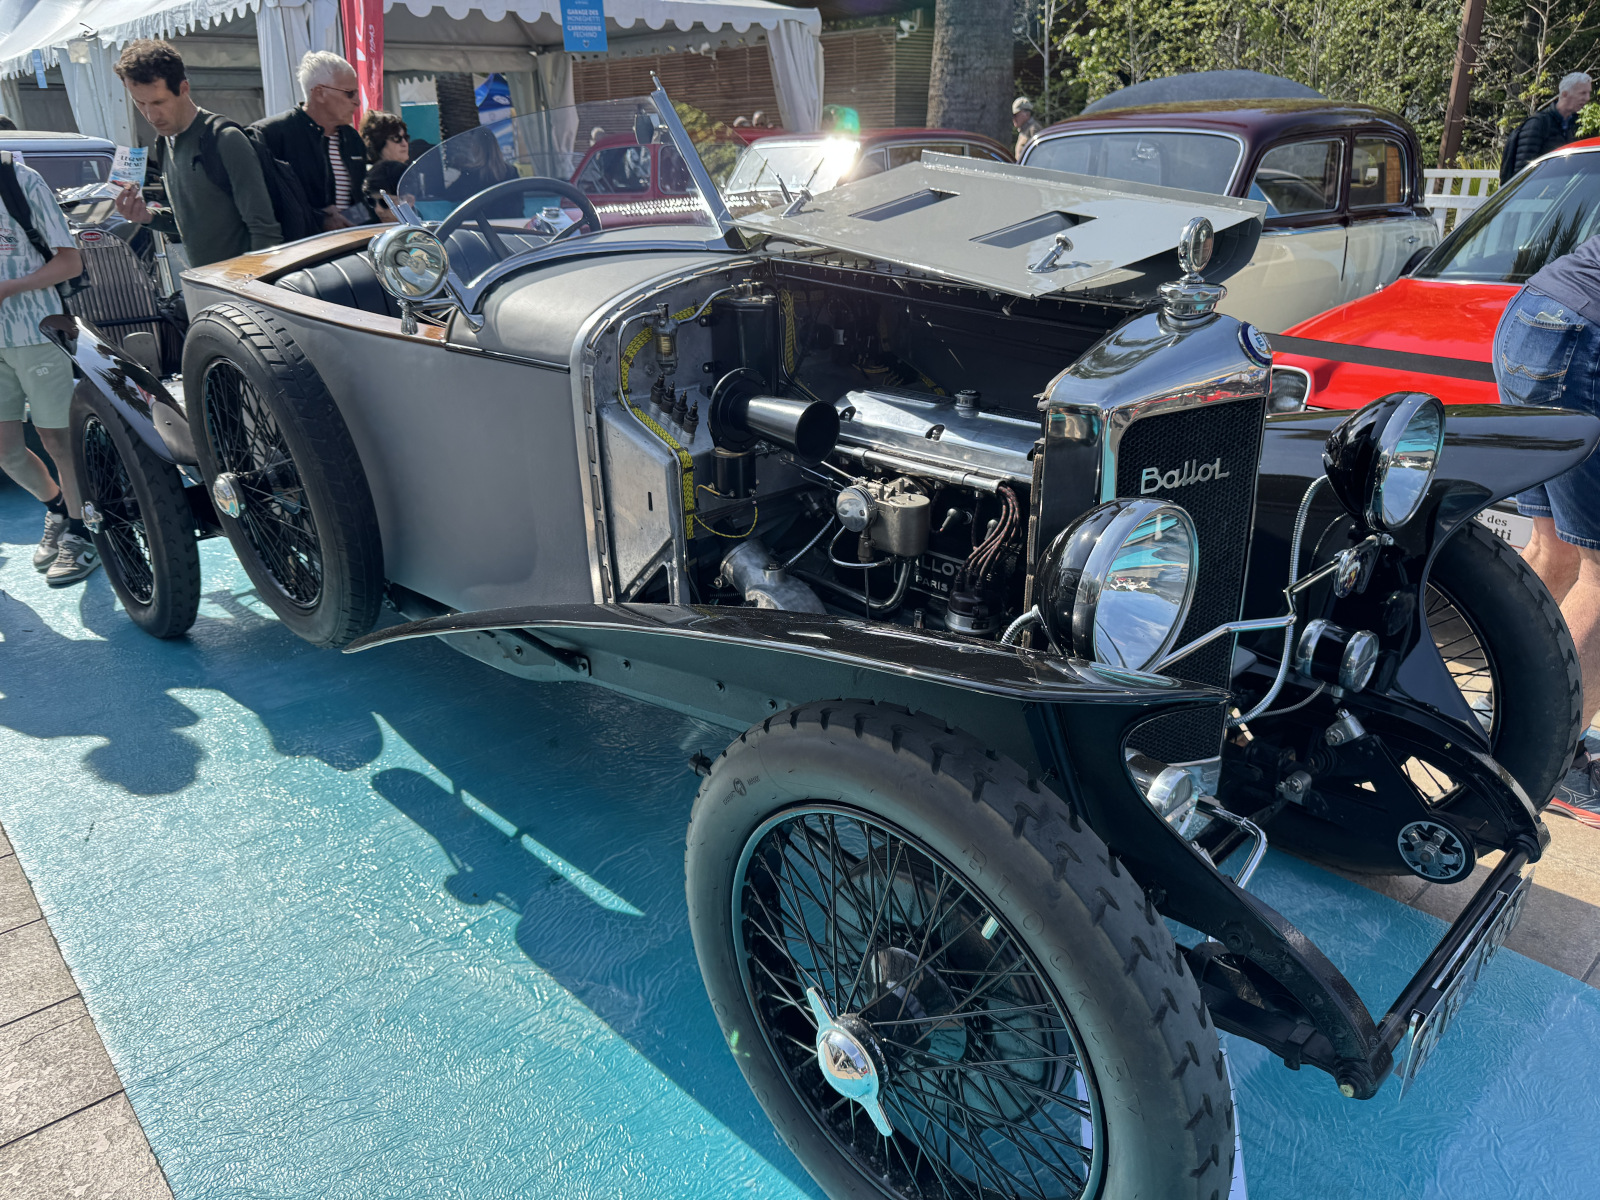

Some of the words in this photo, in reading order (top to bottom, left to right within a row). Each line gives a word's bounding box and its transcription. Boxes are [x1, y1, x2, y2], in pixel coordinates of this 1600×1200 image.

[1487, 514, 1508, 527] des
[915, 574, 948, 593] PARIS
[962, 843, 1146, 1122] BLOCKLEY
